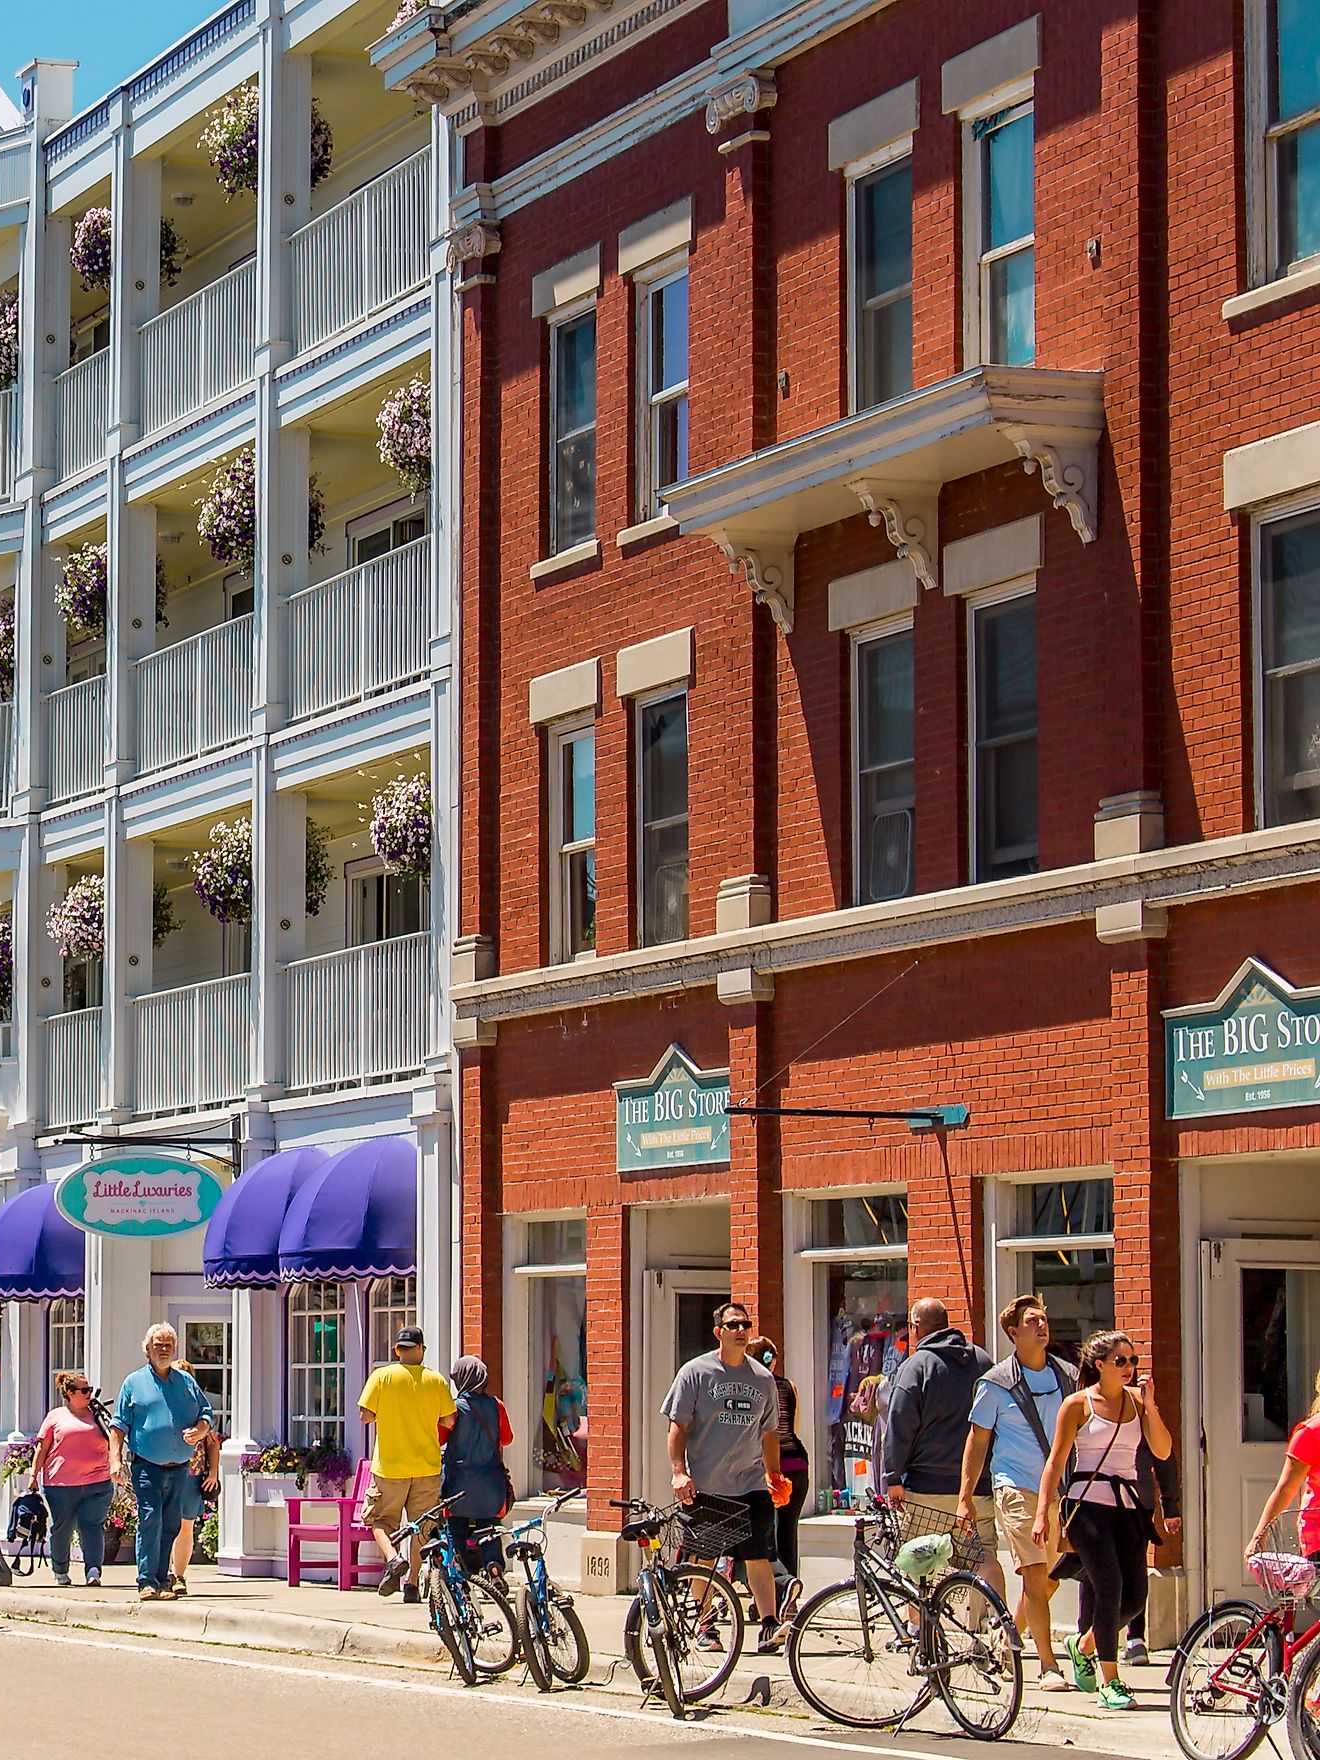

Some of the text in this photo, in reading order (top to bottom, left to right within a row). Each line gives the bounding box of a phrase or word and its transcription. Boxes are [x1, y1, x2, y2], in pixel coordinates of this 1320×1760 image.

[1174, 1026, 1215, 1062] THE
[1222, 1014, 1269, 1056] BIG
[1206, 1063, 1313, 1086] With The Little Prices
[622, 1097, 650, 1125] THE
[654, 1089, 684, 1121] BIG
[642, 1134, 658, 1146] With
[660, 1131, 672, 1143] The
[673, 1129, 690, 1142] Little
[93, 1181, 192, 1198] Little Luxuries
[719, 1412, 757, 1426] SPARTANS
[586, 1555, 610, 1578] 1898
